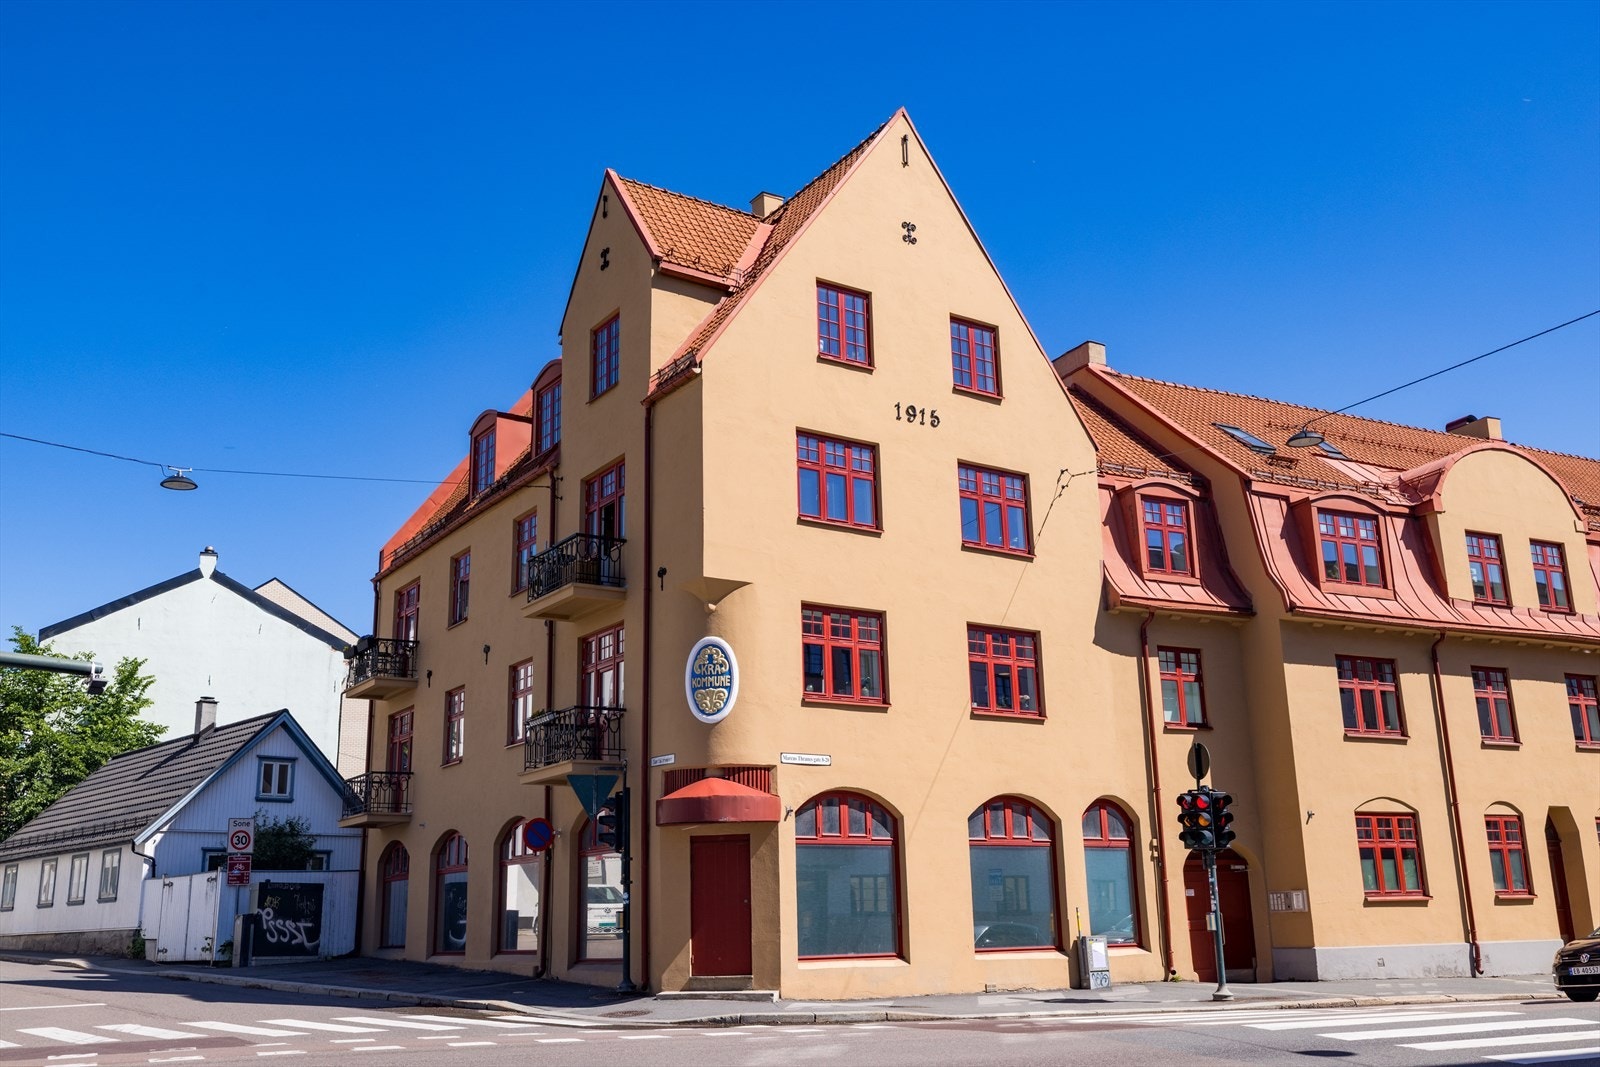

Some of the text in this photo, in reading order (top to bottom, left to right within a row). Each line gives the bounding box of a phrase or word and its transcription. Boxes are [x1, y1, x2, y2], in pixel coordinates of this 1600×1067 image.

[894, 401, 941, 428] 1915
[701, 664, 721, 675] KRA
[692, 676, 730, 688] KOMMUNE
[234, 835, 248, 846] 30
